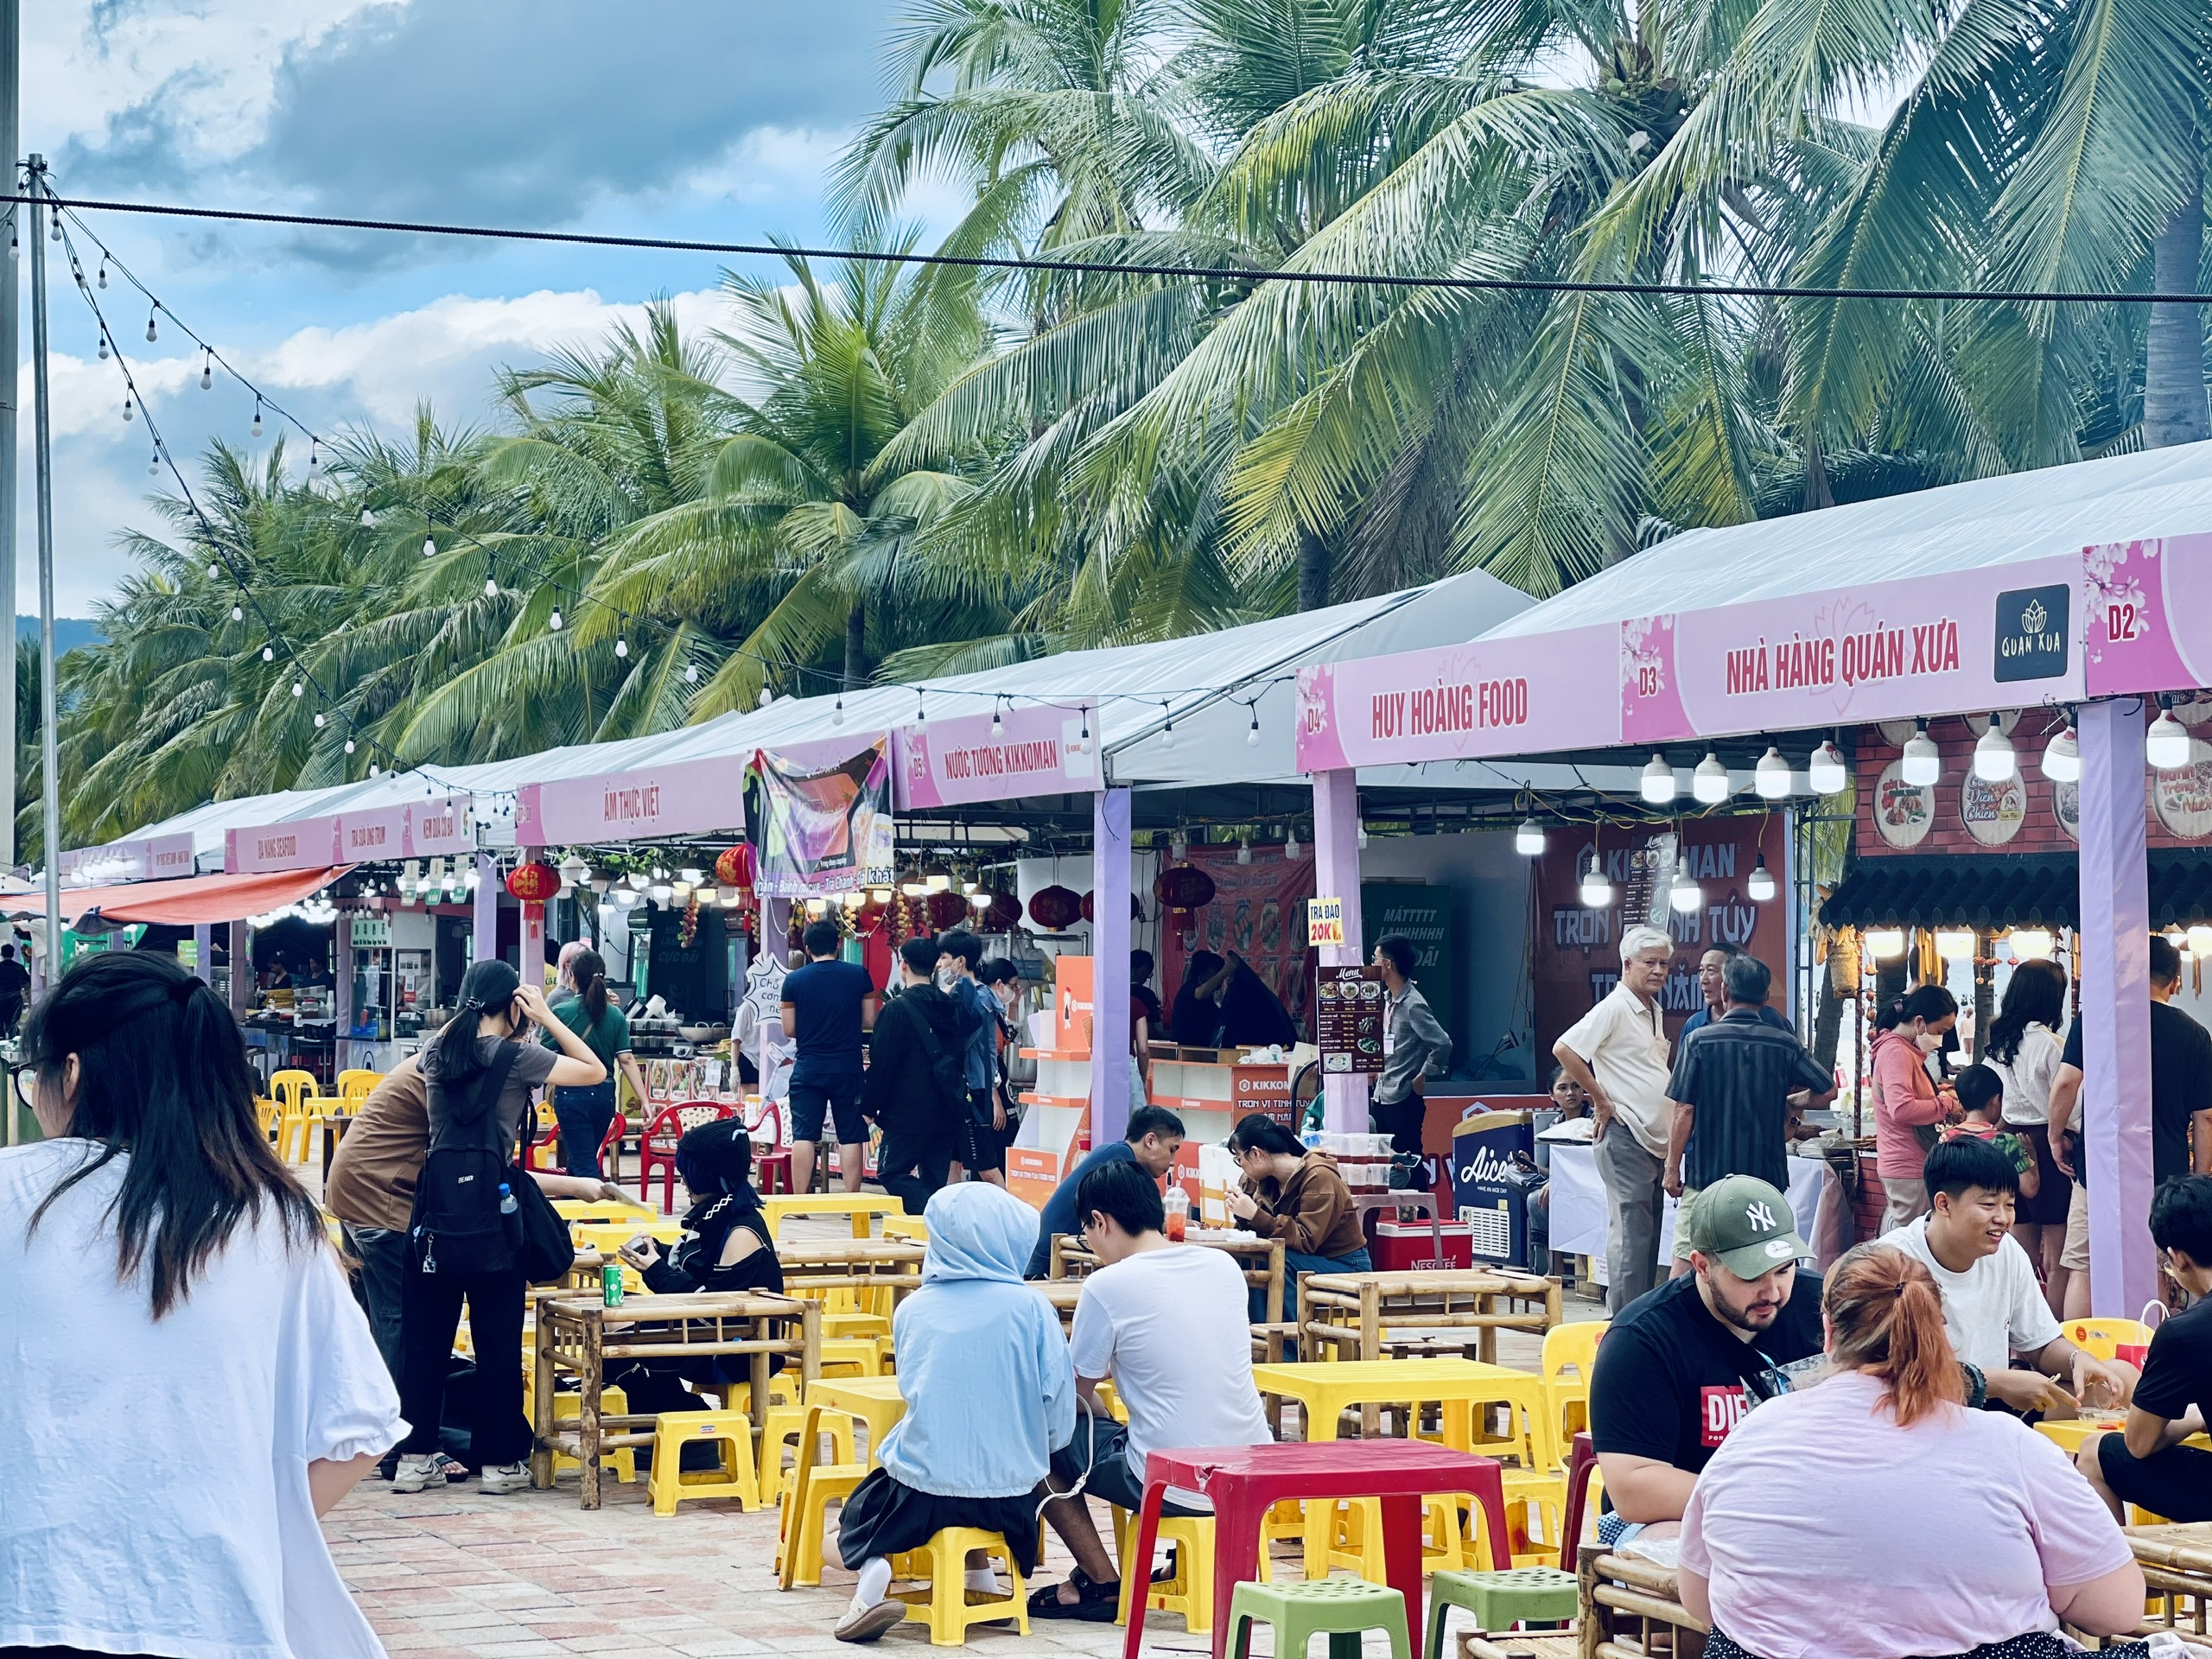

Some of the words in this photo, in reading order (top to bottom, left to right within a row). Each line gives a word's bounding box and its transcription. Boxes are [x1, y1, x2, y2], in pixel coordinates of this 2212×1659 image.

[2108, 603, 2135, 641] D2
[1726, 637, 1770, 696] NHÀ
[1775, 632, 1834, 690] HÀNG
[1840, 620, 1904, 688] QUÁN
[1910, 617, 1960, 675] XƯA
[1639, 665, 1657, 696] D3
[1307, 707, 1321, 734] D4
[1371, 691, 1406, 740] HUY
[1410, 677, 1473, 736] HOÀNG
[1478, 677, 1528, 730] FOOD
[913, 757, 923, 778] D5
[944, 746, 970, 780] NƯỚC
[970, 745, 1003, 778] TƯƠNG
[1004, 740, 1058, 775] KIKKOMAN
[619, 786, 640, 825] THỰC
[641, 780, 660, 823] VIỆT
[1607, 842, 1736, 882] KIMAN
[1311, 923, 1332, 941] 20K
[1554, 907, 1610, 953] TRỌN
[1708, 894, 1755, 944] TÚY
[1335, 967, 1363, 981] Menu
[1411, 1255, 1457, 1271] NESCFÉ
[1707, 1394, 1748, 1432] DIE
